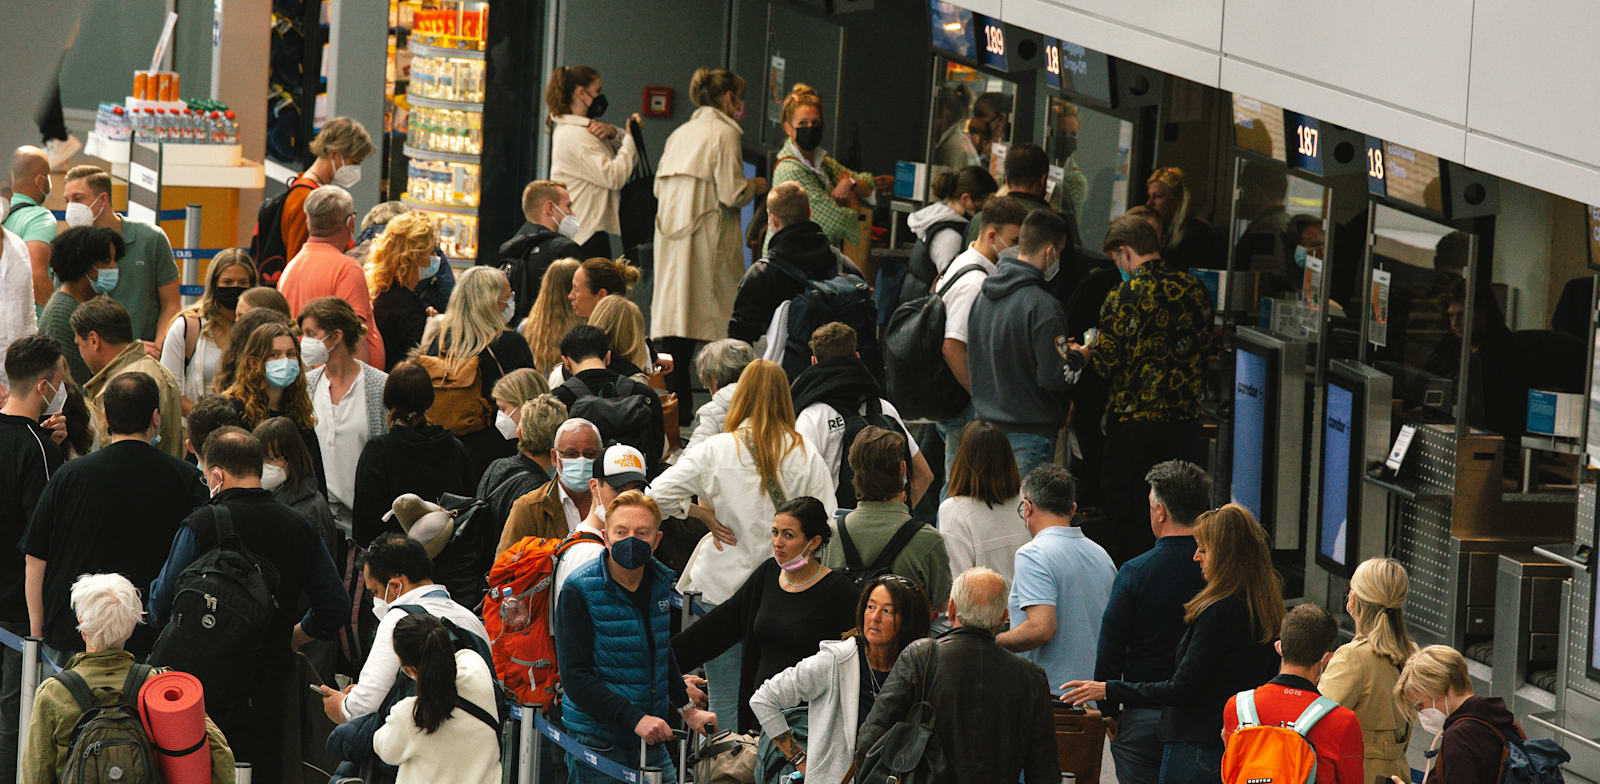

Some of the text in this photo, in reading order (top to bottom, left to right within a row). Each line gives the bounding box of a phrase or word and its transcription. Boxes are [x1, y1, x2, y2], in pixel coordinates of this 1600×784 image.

[984, 24, 1004, 56] 189
[1297, 124, 1318, 158] 187
[1238, 382, 1258, 398] condor
[1328, 416, 1346, 433] condor
[1283, 687, 1303, 697] GORE
